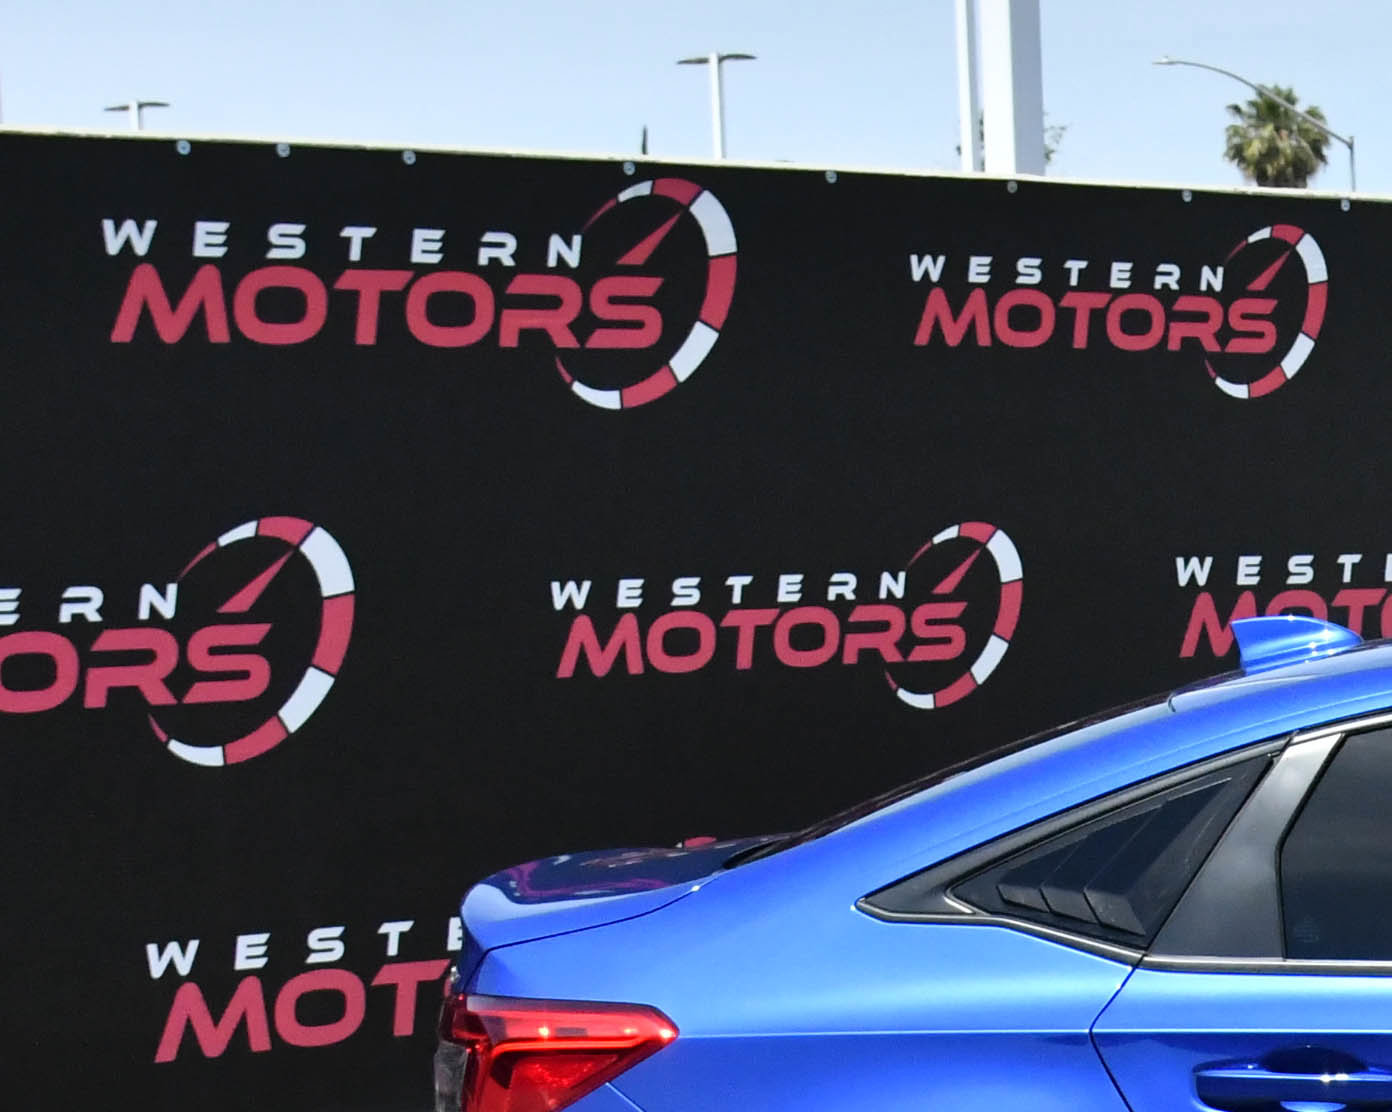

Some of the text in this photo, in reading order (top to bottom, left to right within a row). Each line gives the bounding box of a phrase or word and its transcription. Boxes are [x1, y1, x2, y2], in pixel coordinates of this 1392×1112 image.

[102, 219, 582, 268] WESTERN
[910, 254, 1224, 292] WESTERN
[111, 263, 665, 349] MOTORS
[914, 287, 1278, 353] MOTORS
[0, 582, 178, 626] ERN
[550, 571, 906, 611] WESTERN
[0, 623, 272, 713] ORS
[556, 601, 967, 678] MOTORS
[155, 959, 451, 1063] MOT
